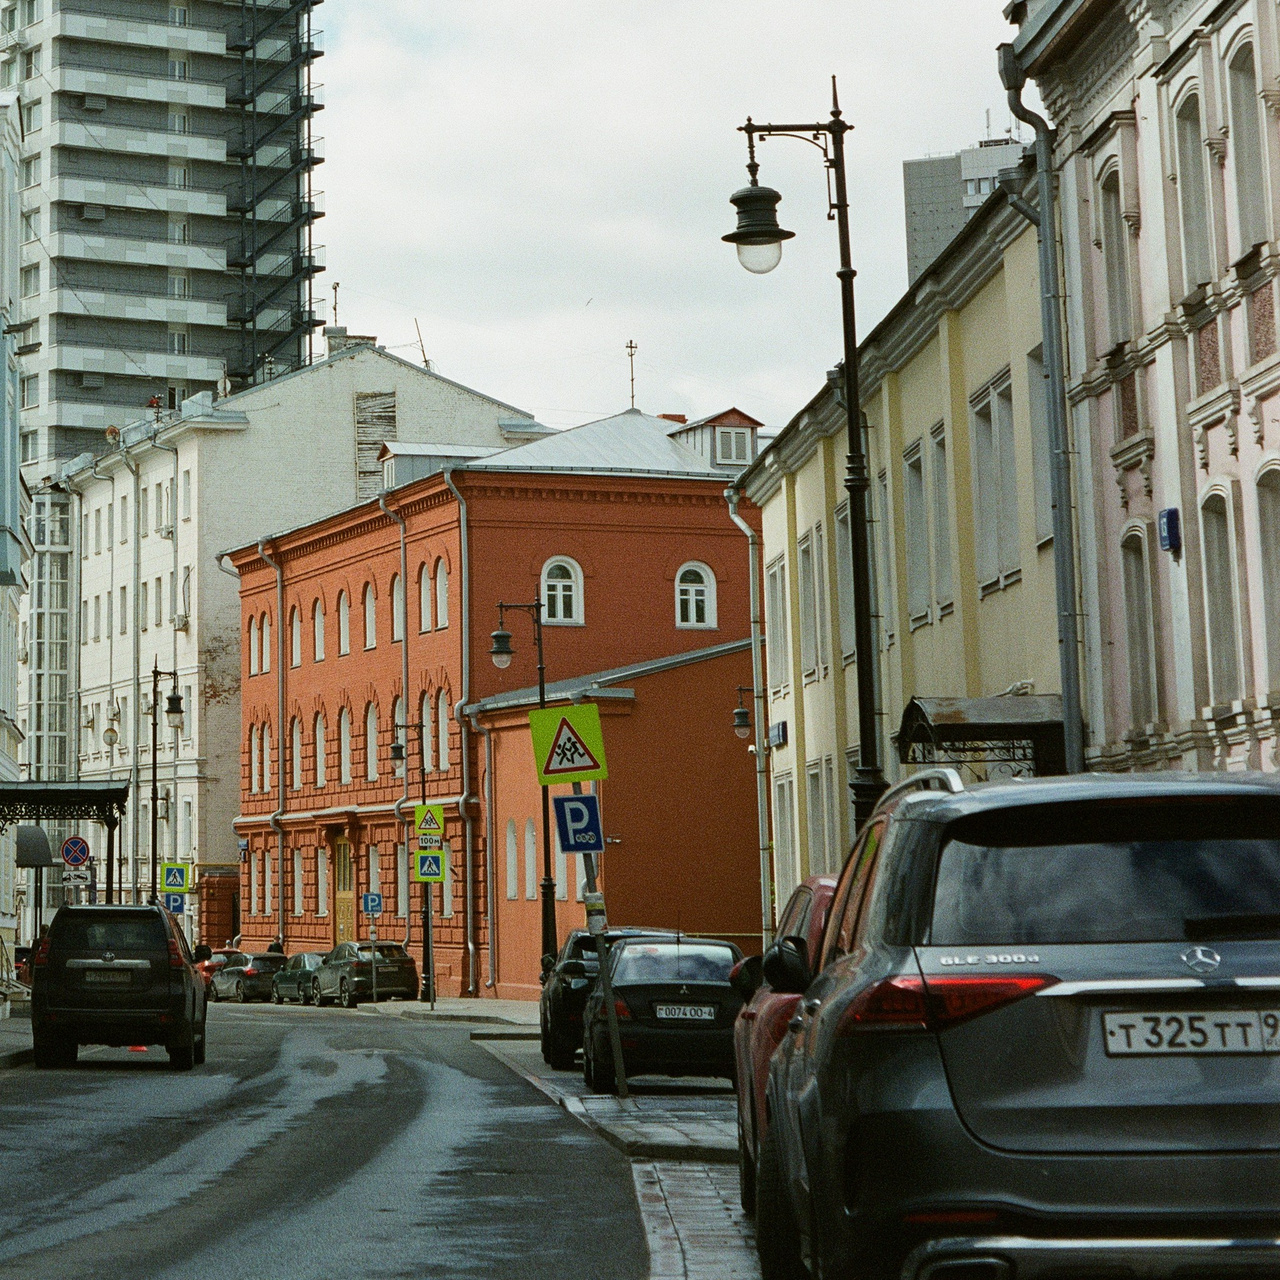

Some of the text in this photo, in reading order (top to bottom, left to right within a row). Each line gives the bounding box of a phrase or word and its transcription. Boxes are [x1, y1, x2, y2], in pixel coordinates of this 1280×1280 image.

[564, 801, 589, 845] P
[170, 895, 181, 911] P
[368, 895, 379, 911] P
[940, 954, 980, 966] GLE
